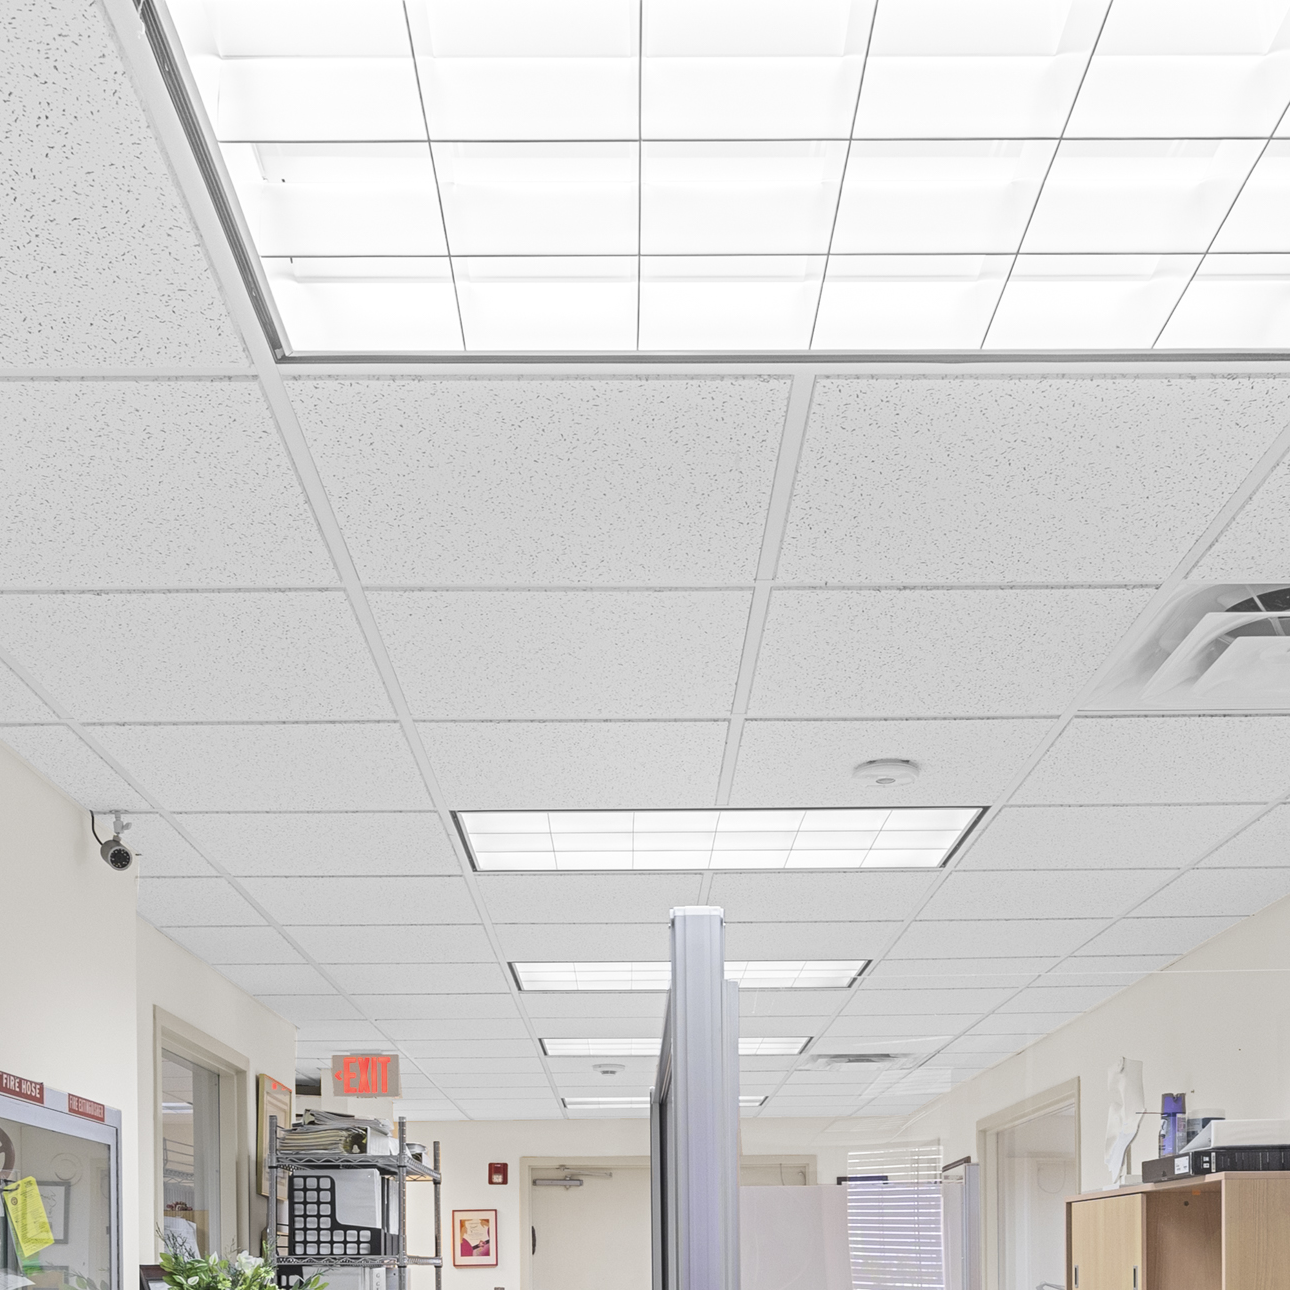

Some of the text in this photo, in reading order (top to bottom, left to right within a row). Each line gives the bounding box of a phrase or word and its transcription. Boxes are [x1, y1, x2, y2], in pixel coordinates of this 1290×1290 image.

[2, 1073, 41, 1098] FIRE HOSE
[343, 1057, 391, 1094] EXIT
[69, 1095, 79, 1111] FIRE
